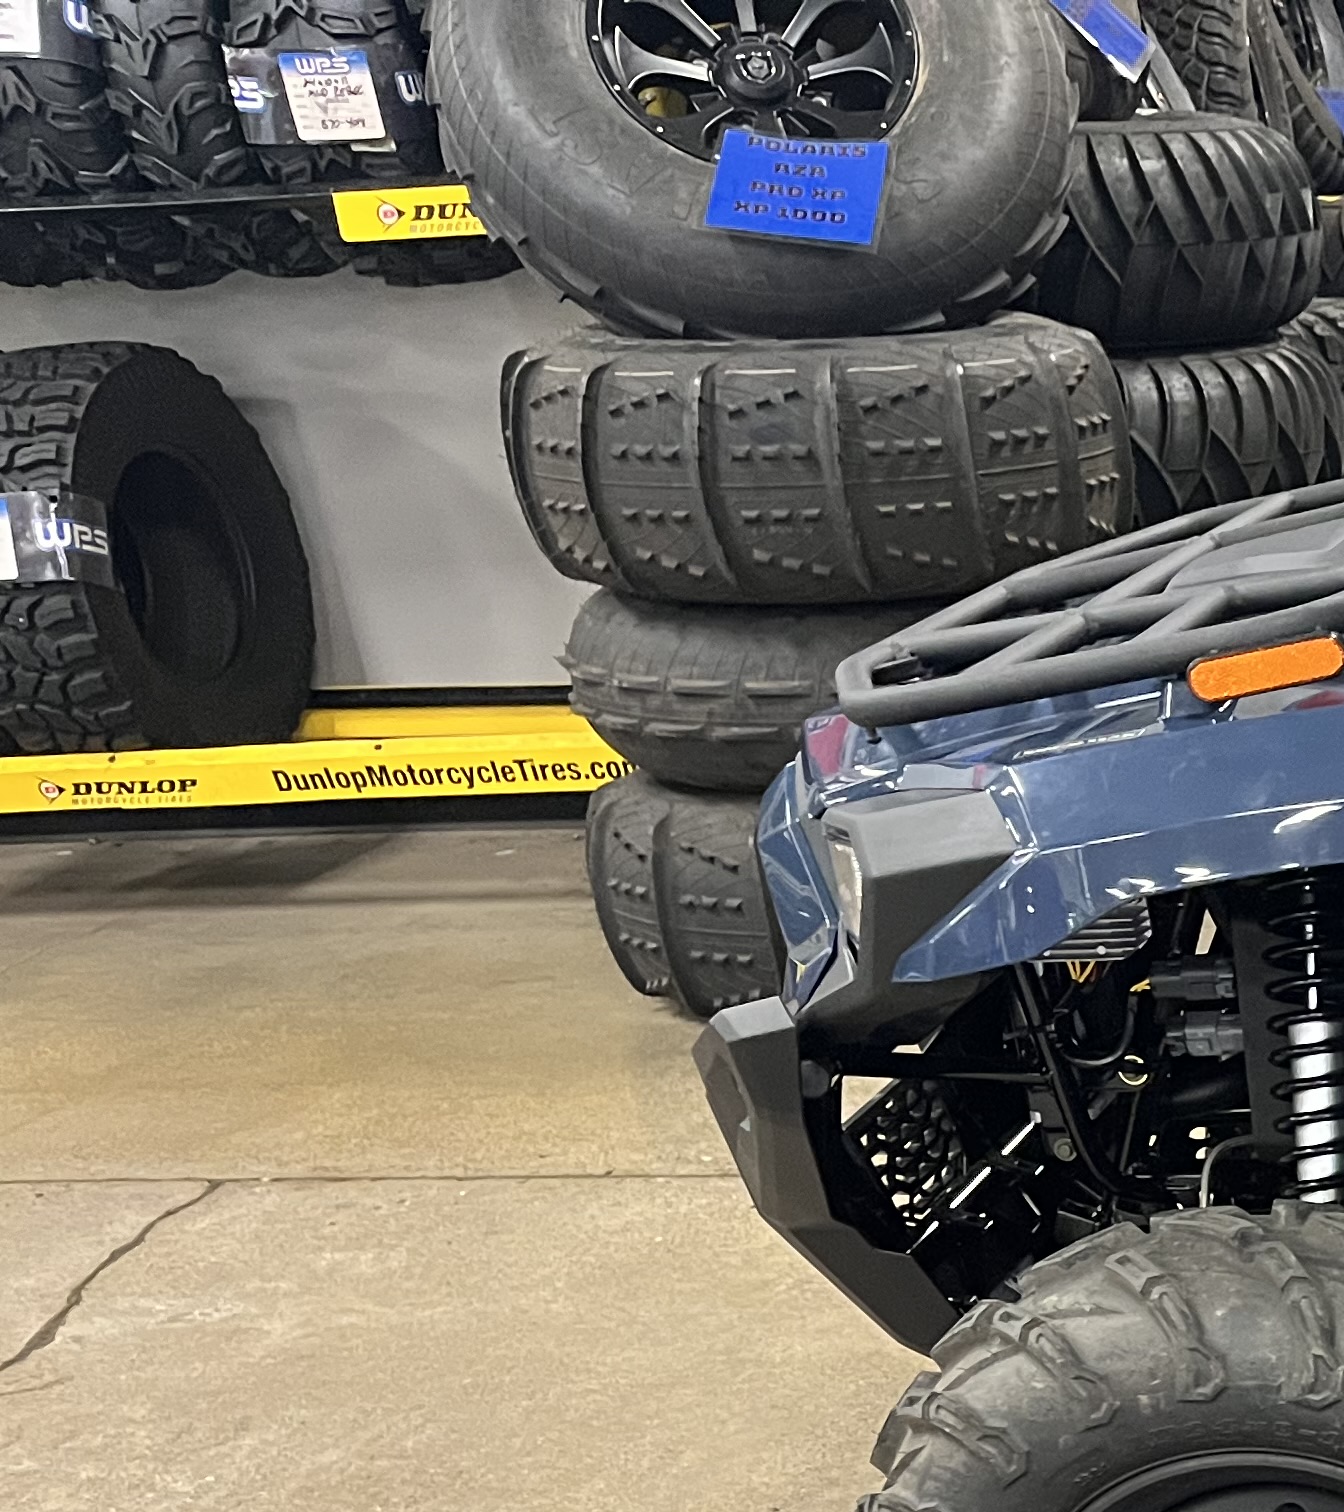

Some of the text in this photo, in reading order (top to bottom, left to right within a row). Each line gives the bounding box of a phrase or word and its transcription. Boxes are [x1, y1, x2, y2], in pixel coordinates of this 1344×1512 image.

[295, 57, 349, 74] WPS
[749, 137, 867, 158] POLARIS
[411, 203, 478, 221] DUN
[33, 520, 109, 556] WPS
[72, 779, 198, 797] DUNLOP
